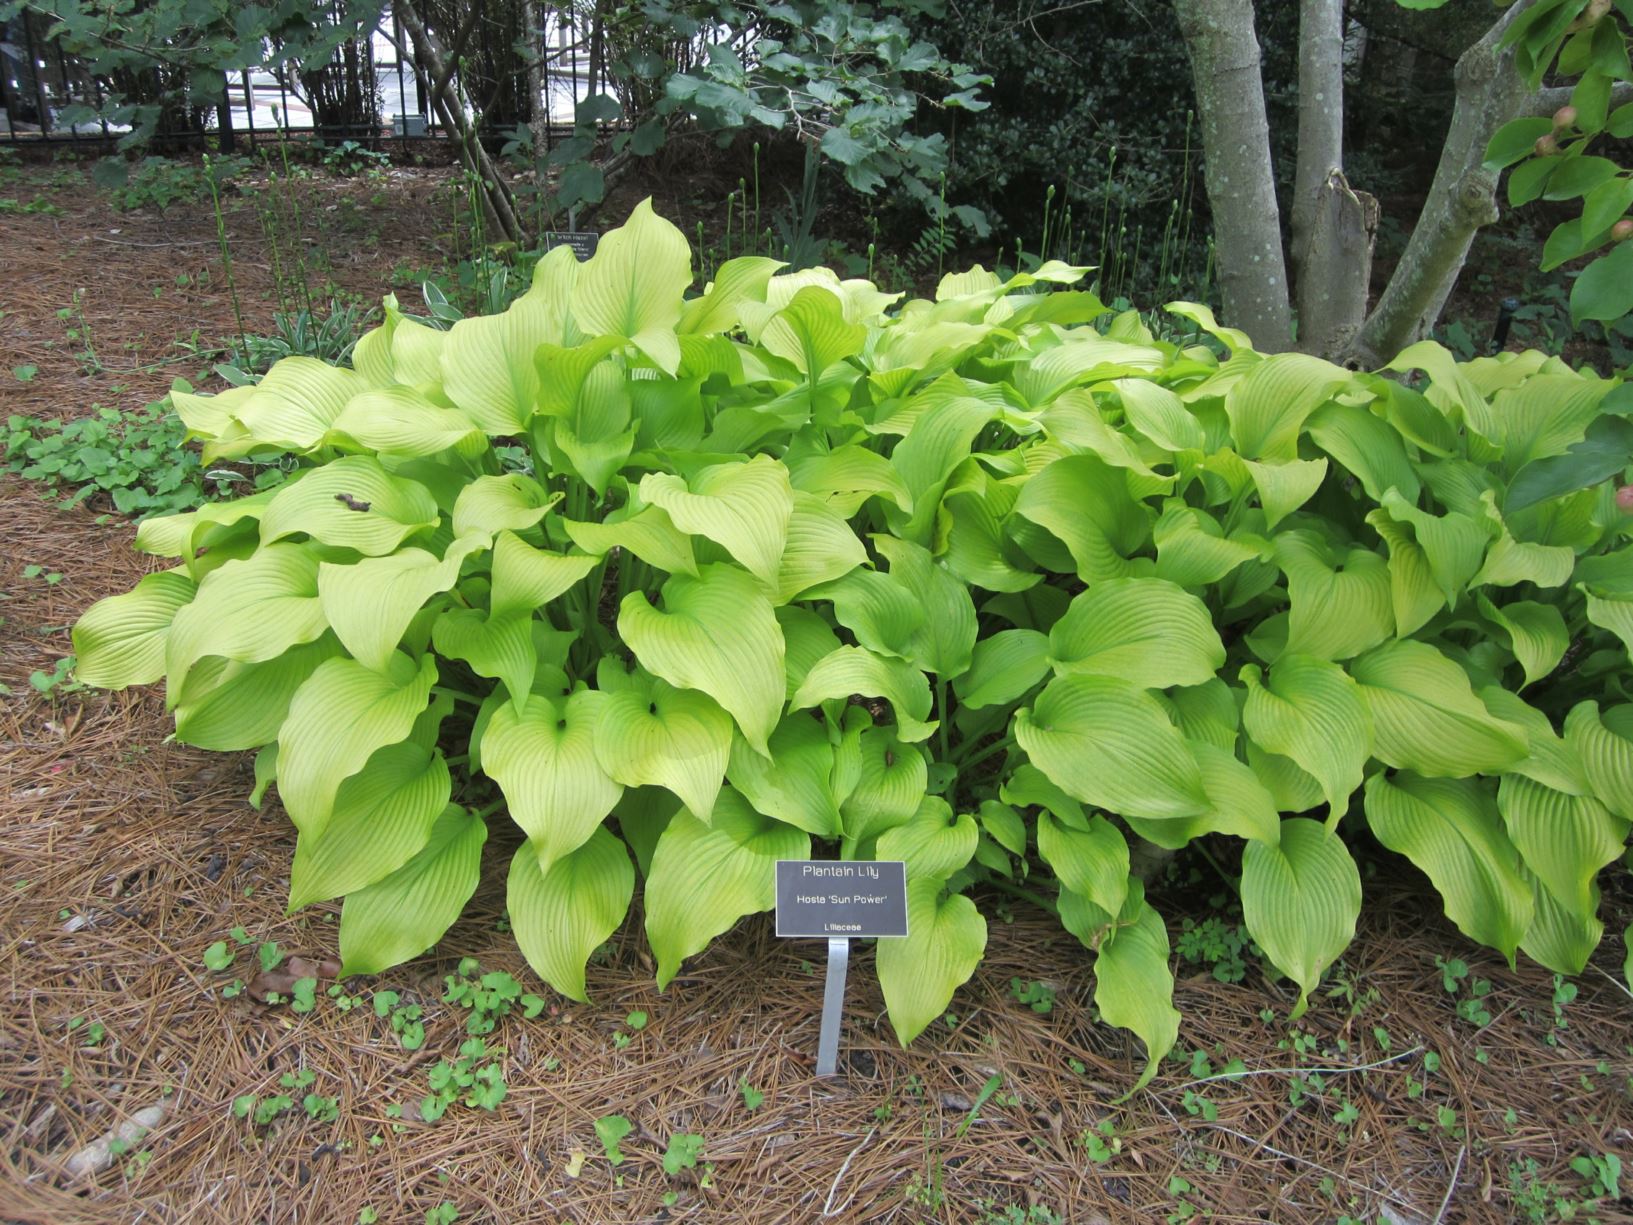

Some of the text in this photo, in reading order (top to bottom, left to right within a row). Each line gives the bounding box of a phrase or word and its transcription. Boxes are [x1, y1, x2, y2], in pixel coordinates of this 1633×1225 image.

[803, 865, 879, 880] Plantain Lily
[796, 895, 888, 904] Hosta 'Sun Power'
[824, 923, 862, 931] Liliaceae
